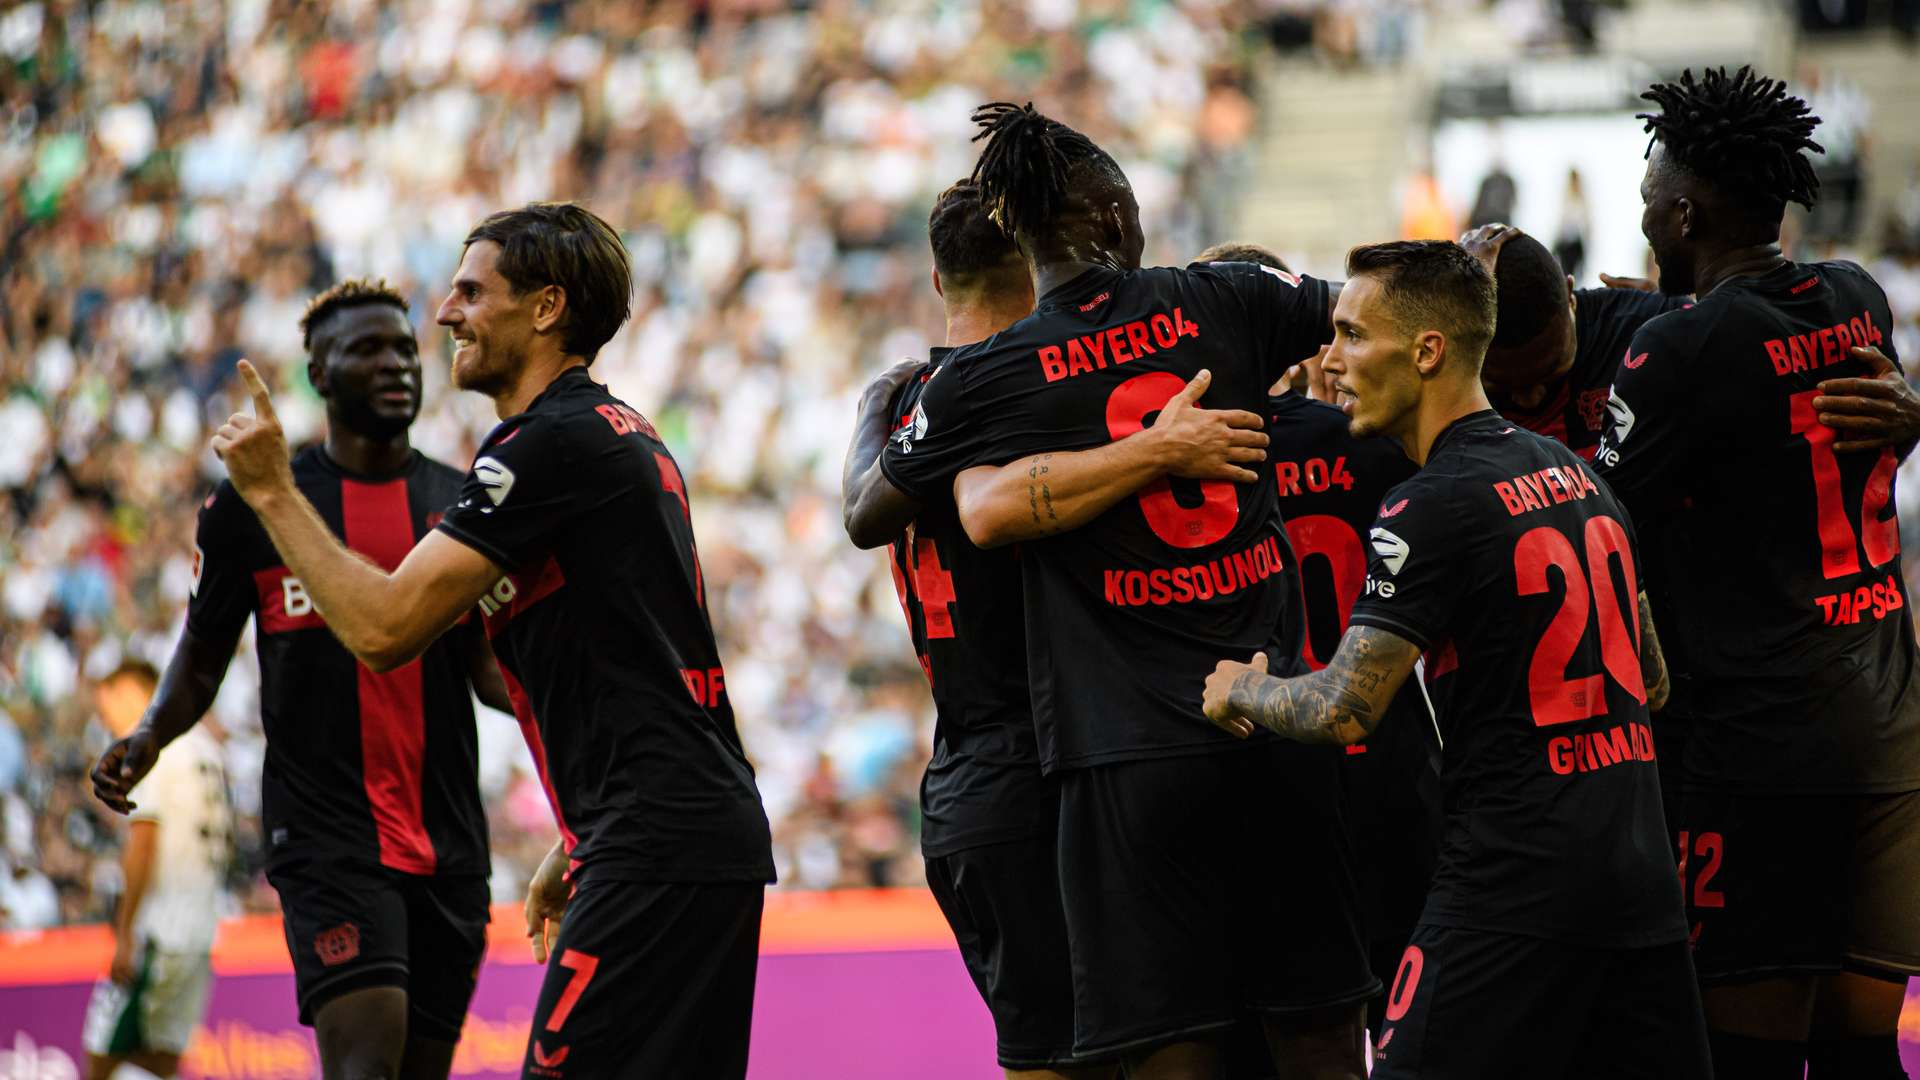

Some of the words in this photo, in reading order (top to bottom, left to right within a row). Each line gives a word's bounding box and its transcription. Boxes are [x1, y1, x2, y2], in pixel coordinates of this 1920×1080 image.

[1104, 536, 1283, 606] KOSSOUNOU
[1365, 574, 1396, 598] ive
[1514, 515, 1647, 727] 20
[545, 948, 600, 1033] 7
[1385, 944, 1424, 1021] 0
